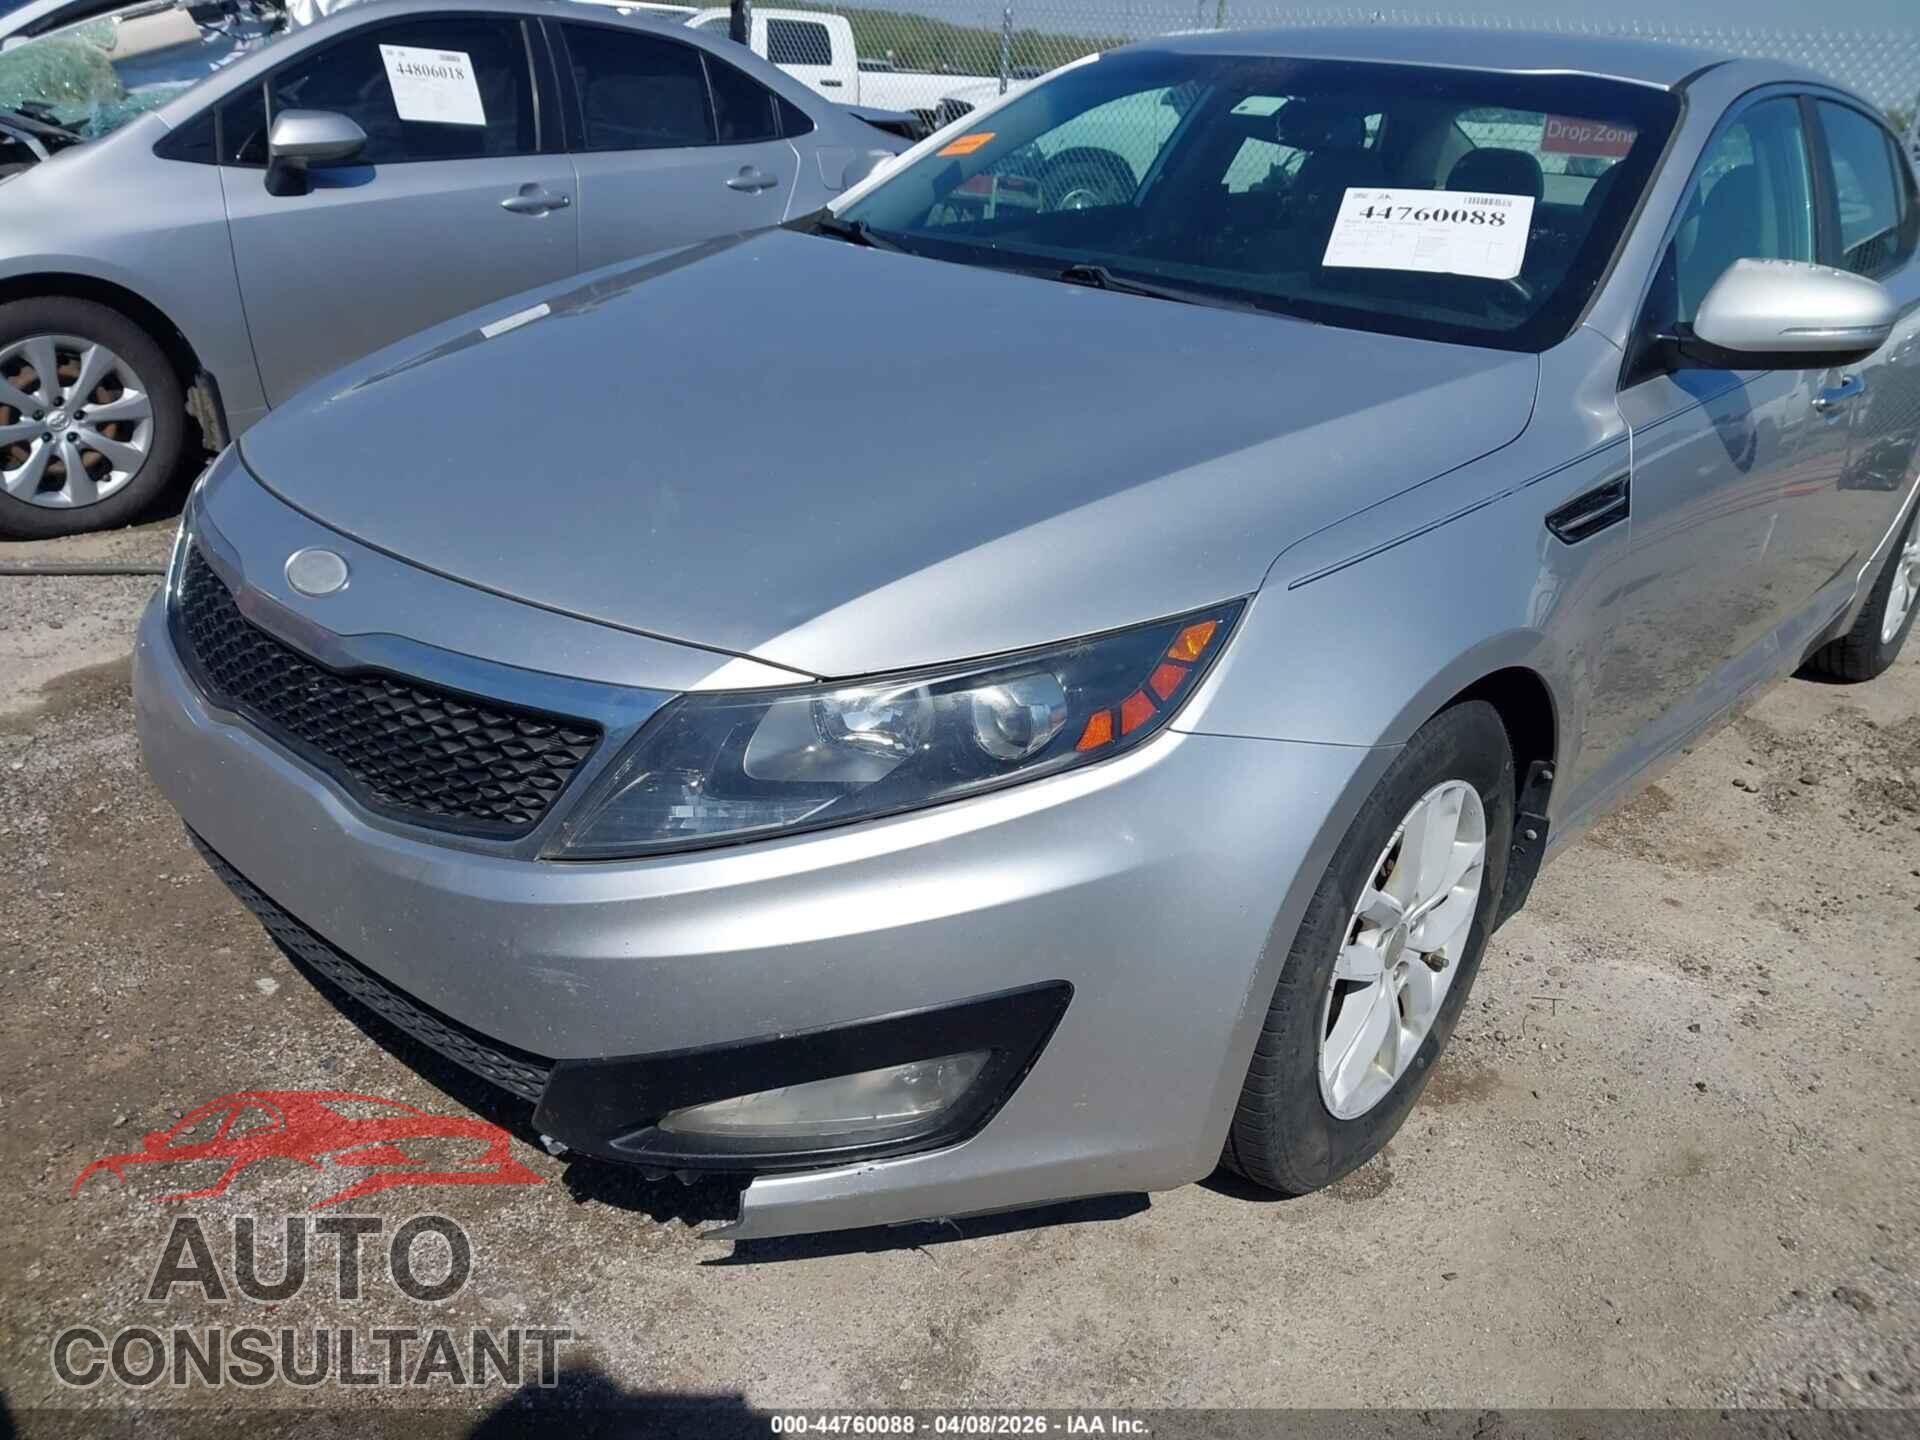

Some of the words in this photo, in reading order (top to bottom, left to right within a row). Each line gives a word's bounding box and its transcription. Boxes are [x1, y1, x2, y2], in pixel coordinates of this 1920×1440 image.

[396, 62, 464, 80] 44806018
[1547, 120, 1594, 144] Drop
[1360, 205, 1505, 227] 44760088
